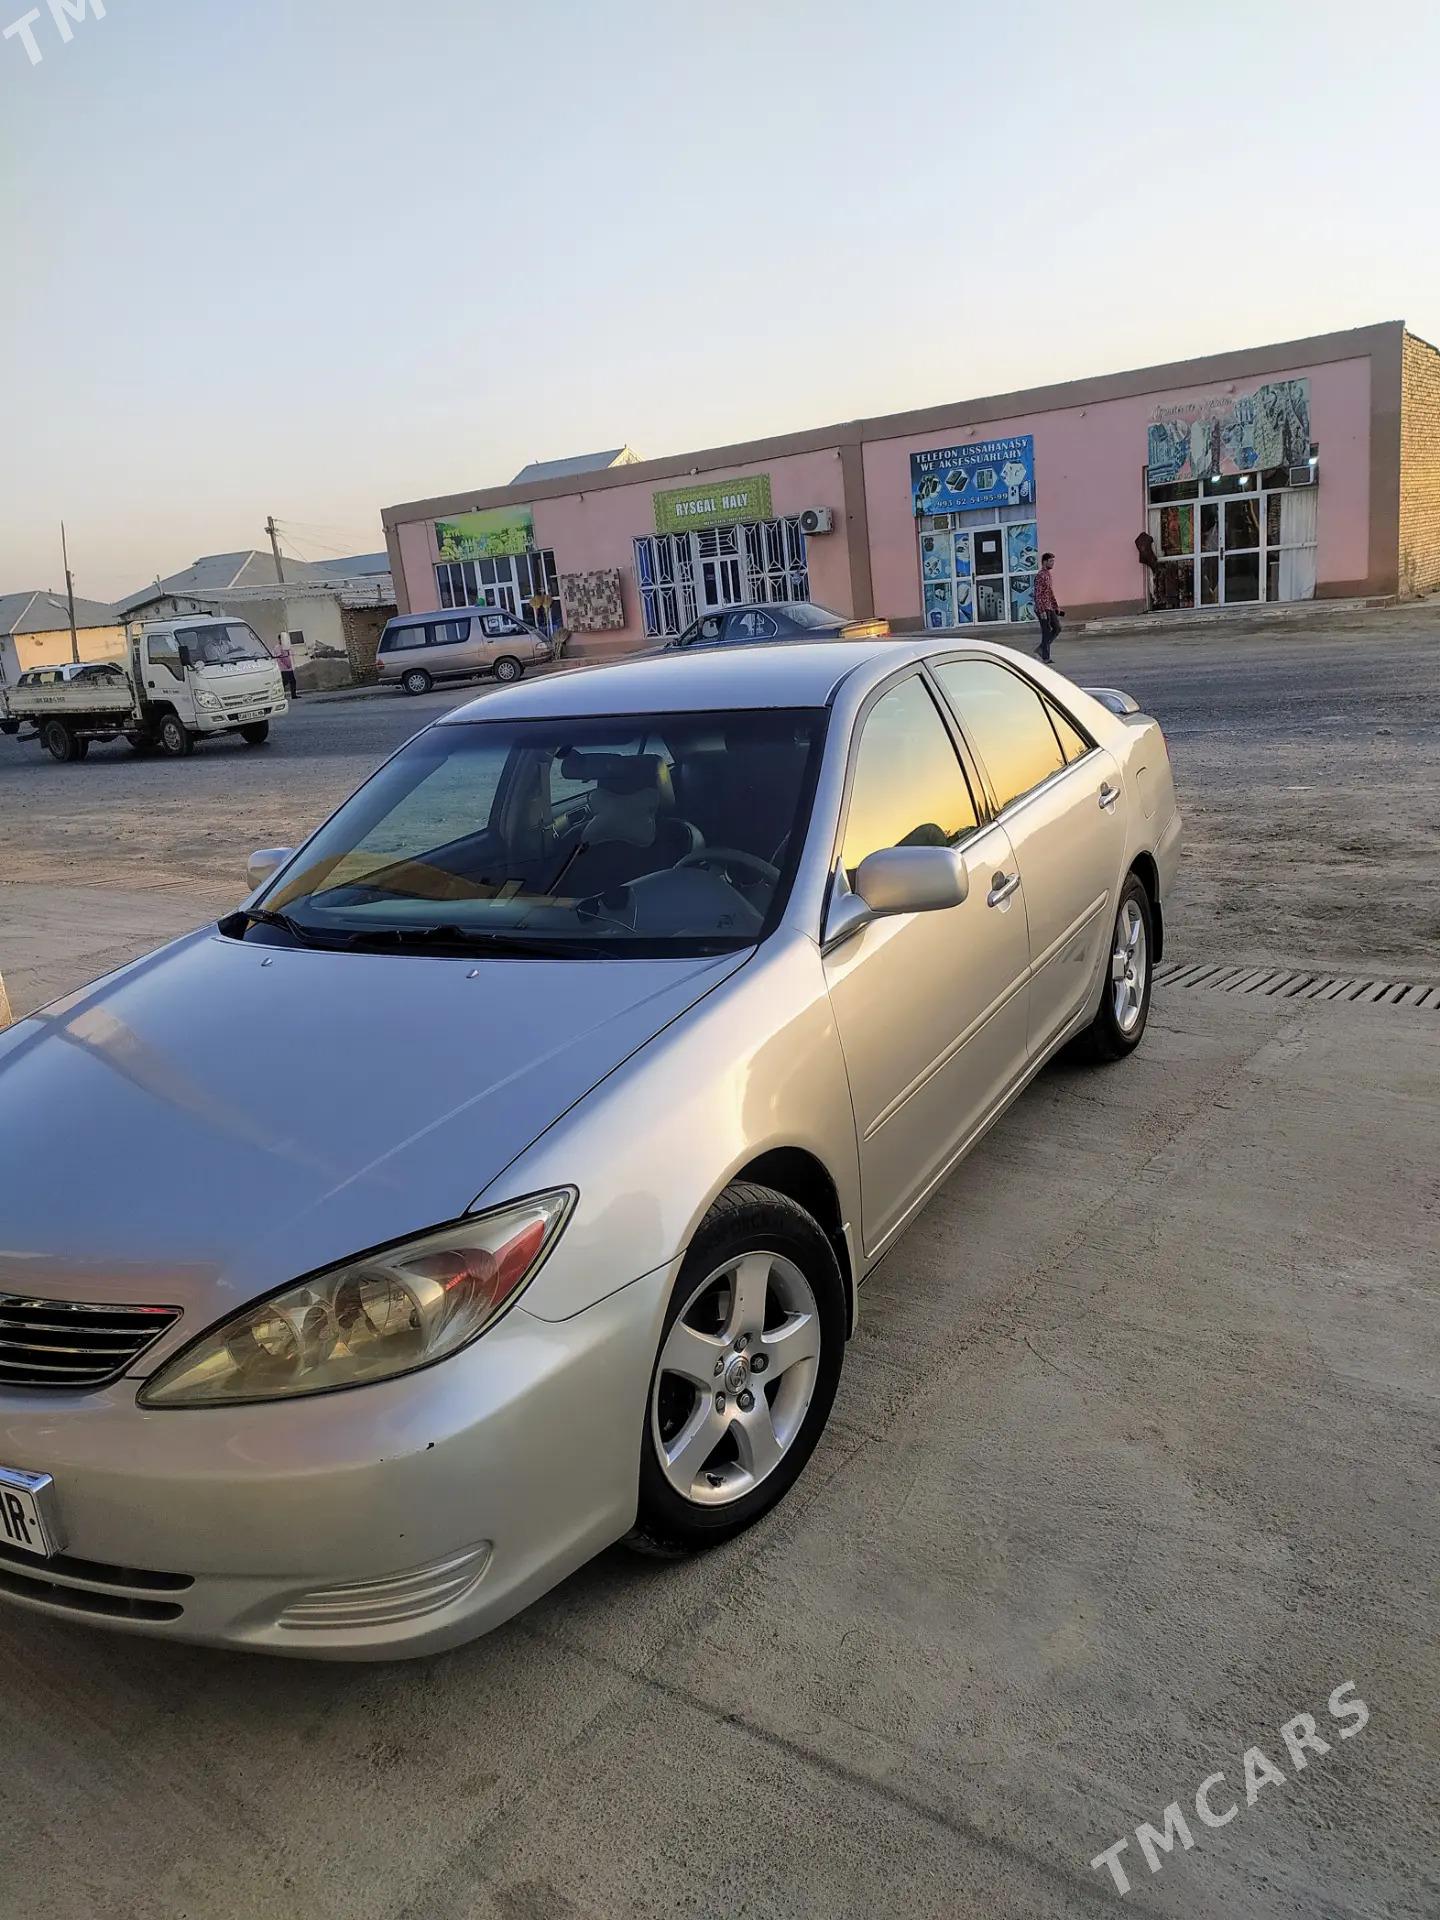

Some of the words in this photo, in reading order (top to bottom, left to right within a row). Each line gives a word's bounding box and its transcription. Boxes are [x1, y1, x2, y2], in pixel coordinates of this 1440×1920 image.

[916, 450, 958, 463] TELEFON
[963, 439, 1028, 456] USSAHANASY
[920, 461, 935, 472] WE
[939, 449, 1022, 469] AKSESSUARLARY
[675, 498, 717, 516] RYSGAL
[722, 493, 748, 509] HALY
[956, 498, 966, 506] 62
